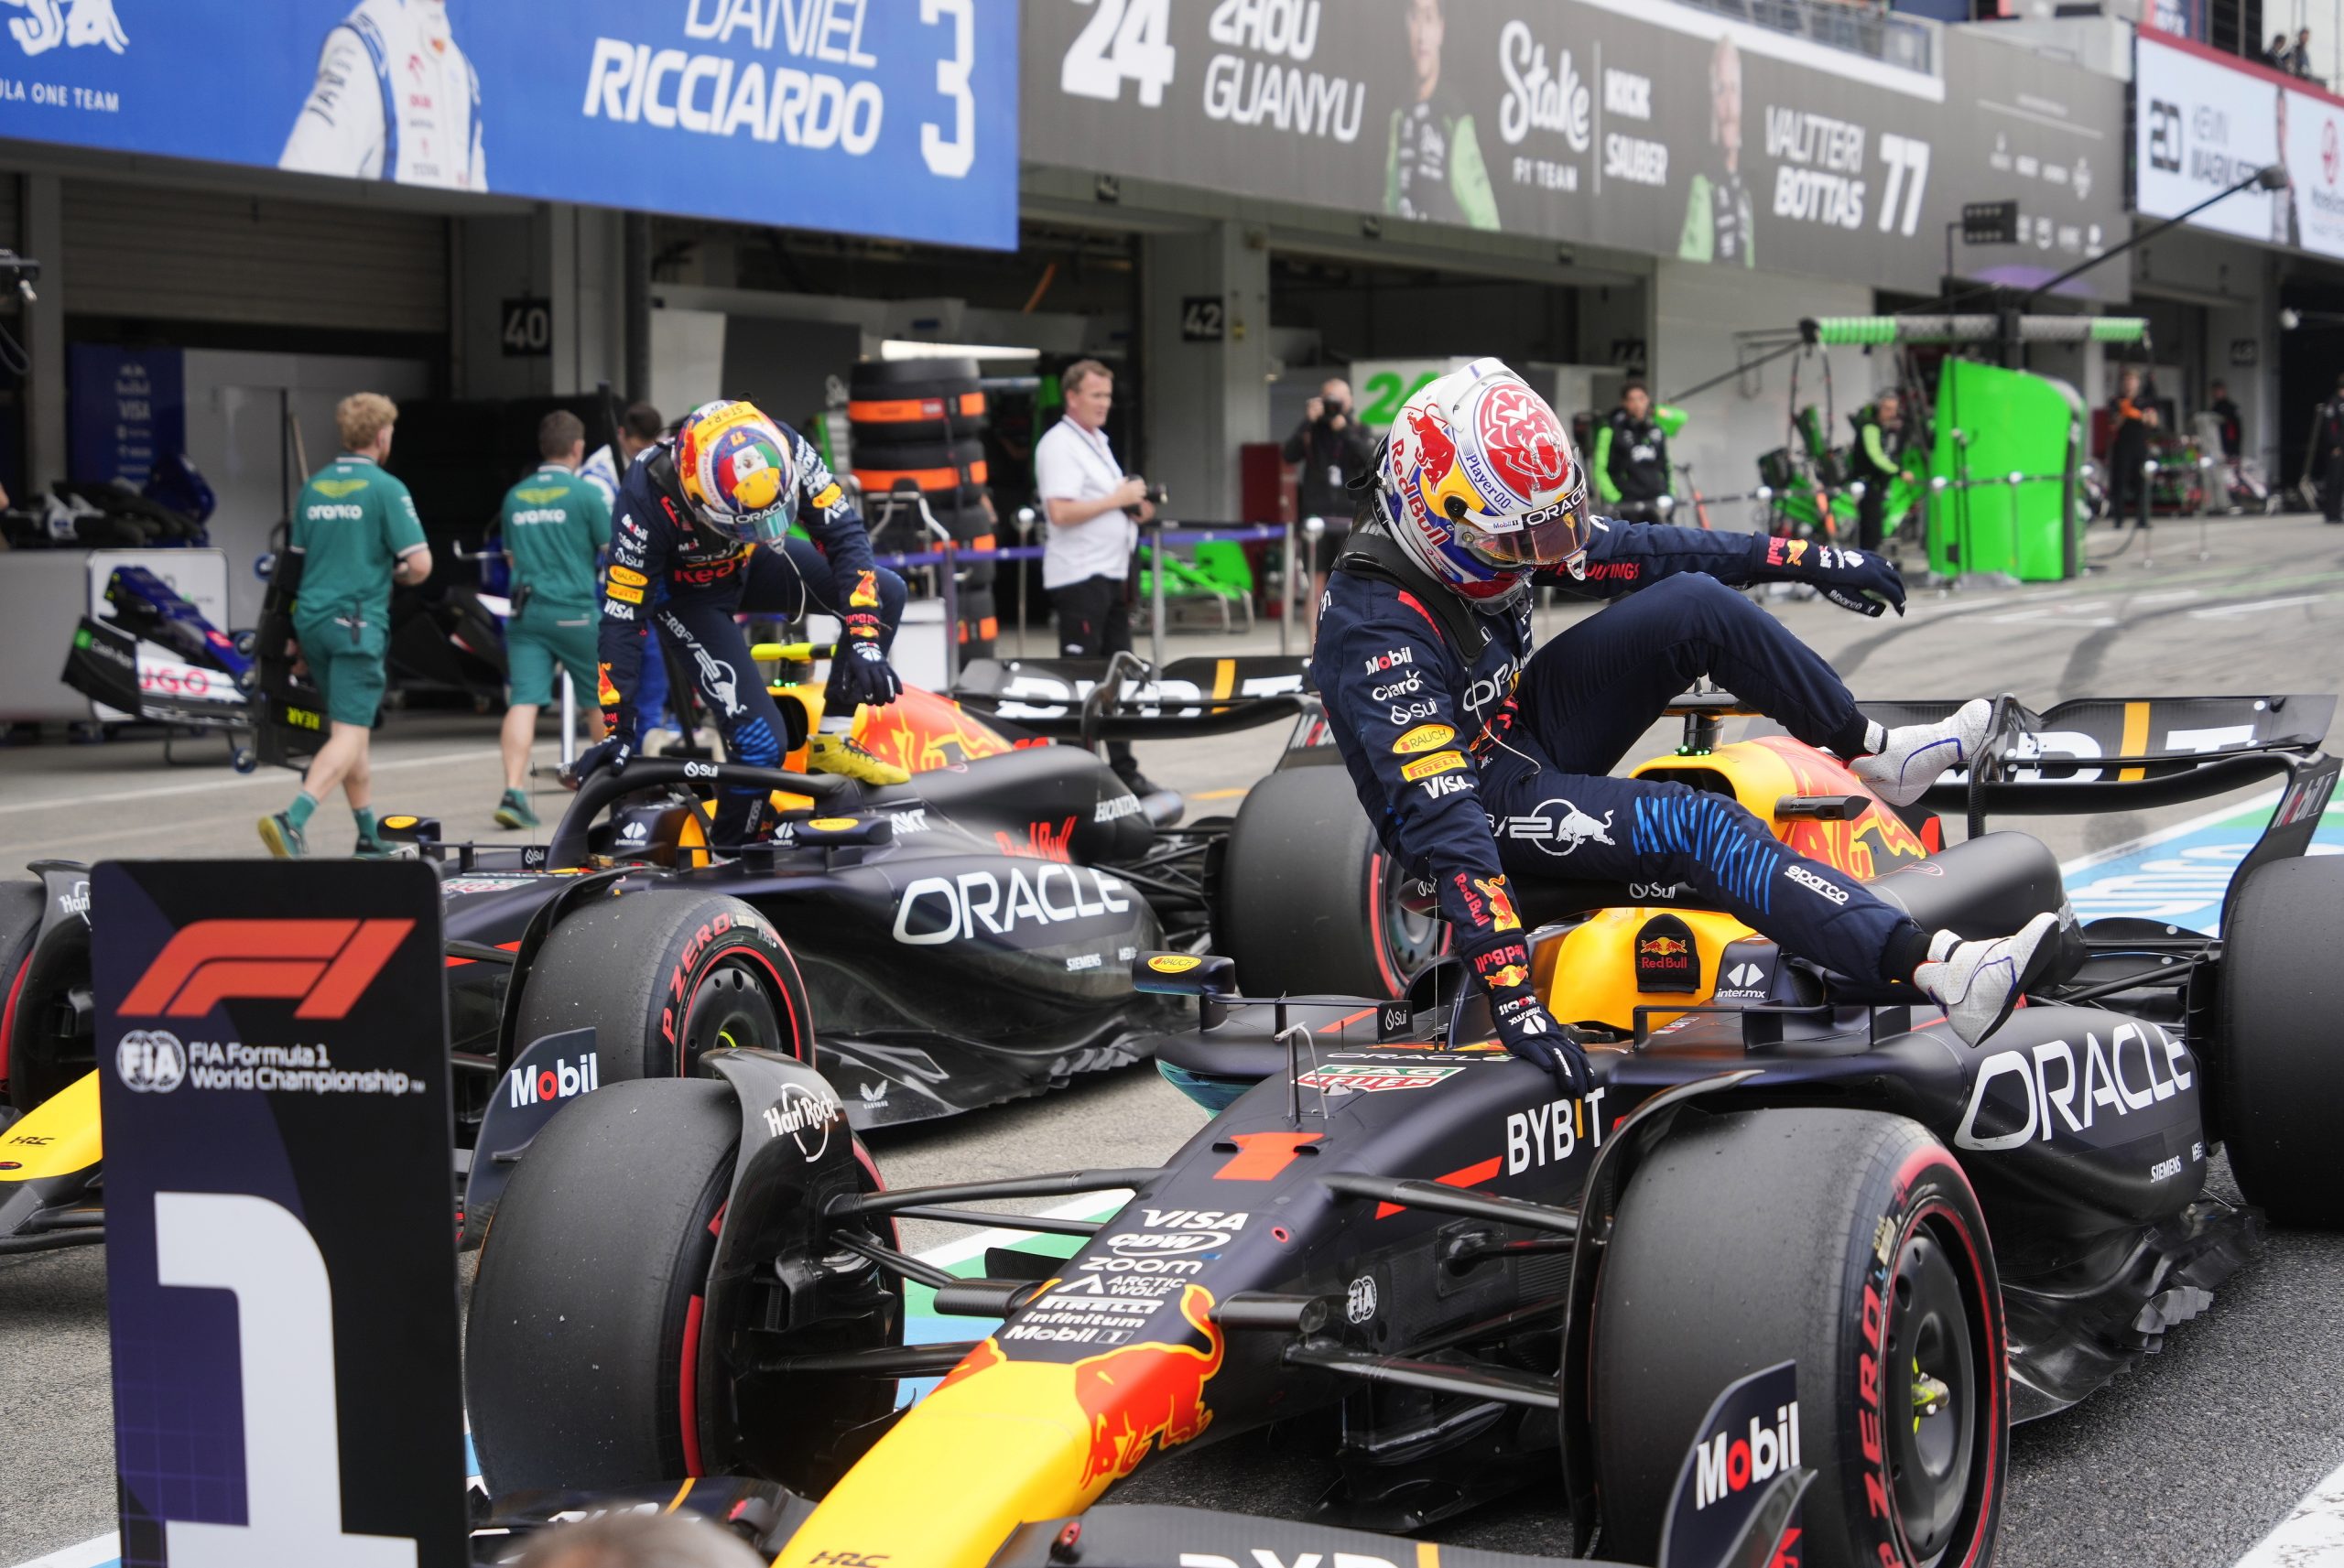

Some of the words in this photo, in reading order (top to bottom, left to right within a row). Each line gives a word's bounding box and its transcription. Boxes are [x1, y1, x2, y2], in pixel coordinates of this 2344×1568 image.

[685, 0, 876, 69] DANIEL
[1209, 0, 1321, 61] ZHOU
[1061, 0, 1176, 107] 24
[31, 82, 68, 107] ONE
[73, 87, 120, 112] TEAM
[582, 38, 884, 156] RICCIARDO
[919, 0, 975, 178] 3
[1203, 54, 1365, 143] GUANYU
[1499, 20, 1590, 153] Stake
[1604, 68, 1651, 120] KICK
[1765, 105, 1865, 174] VALTTERI
[1513, 156, 1534, 182] F1
[1536, 160, 1579, 192] TEAM
[1604, 133, 1669, 186] SAUBER
[1774, 163, 1866, 229] BOTTAS
[1877, 132, 1931, 237] 77
[505, 307, 548, 350] 40
[1184, 300, 1222, 340] 42
[1466, 453, 1498, 497] Player
[1391, 438, 1416, 496] Red
[1405, 491, 1451, 548] Bull
[307, 504, 364, 521] aramco
[622, 513, 649, 542] Mobil
[1492, 522, 1513, 530] Mobil
[625, 554, 645, 568] Sui
[1766, 535, 1786, 567] Bull
[603, 598, 635, 621] VISA
[1829, 589, 1863, 611] sparco
[1365, 646, 1414, 676] Mobil
[1373, 672, 1422, 701] Claro
[286, 705, 320, 730] REAR
[1410, 698, 1438, 719] Sui
[1410, 728, 1448, 749] RAUCH
[700, 764, 719, 777] Sui
[1408, 753, 1461, 779] PIRELLI
[1419, 775, 1475, 800] VISA
[1094, 793, 1143, 823] HONDA
[534, 849, 545, 861] Sui
[1454, 871, 1478, 903] Red
[1468, 896, 1492, 927] Bull
[1650, 881, 1677, 900] Sui
[1784, 864, 1850, 906] sparco
[893, 863, 1132, 946] ORACLE
[115, 919, 418, 1021] F1
[1066, 953, 1102, 972] SIEMENS
[1160, 957, 1193, 967] RAUCH
[1473, 948, 1504, 974] Bull
[1642, 957, 1665, 969] Red
[1666, 957, 1687, 969] Bull
[662, 1007, 676, 1045] P
[669, 912, 732, 1003] ZERO
[1717, 988, 1766, 999] inter.mx
[1394, 1011, 1407, 1026] Sui
[189, 1042, 223, 1065] FIA
[226, 1042, 315, 1067] Formula
[316, 1044, 331, 1066] 1
[1327, 1053, 1516, 1063] ORACLE
[189, 1066, 255, 1091] World
[255, 1067, 410, 1096] Championship
[510, 1052, 599, 1108] Mobil
[1305, 1076, 1433, 1087] HEUER
[1330, 1066, 1448, 1076] TAG
[1953, 1022, 2193, 1152] ORACLE
[763, 1099, 805, 1138] Hard
[800, 1091, 840, 1130] Rock
[9, 1135, 57, 1145] HRC
[1507, 1087, 1605, 1177] BYBIT
[1211, 1131, 1326, 1182] 1
[2150, 1155, 2181, 1184] SIEMENS
[1141, 1209, 1250, 1231] VISA
[1079, 1257, 1203, 1275] zoom
[1105, 1275, 1187, 1289] ARCTIC
[1110, 1285, 1171, 1297] WOLF
[1036, 1295, 1165, 1314] PIRELLI
[1004, 1325, 1099, 1344] Mobil
[154, 1190, 418, 1568] 1
[1860, 1284, 1891, 1520] ZERO
[1696, 1401, 1801, 1510] Mobil
[808, 1550, 893, 1567] HRC
